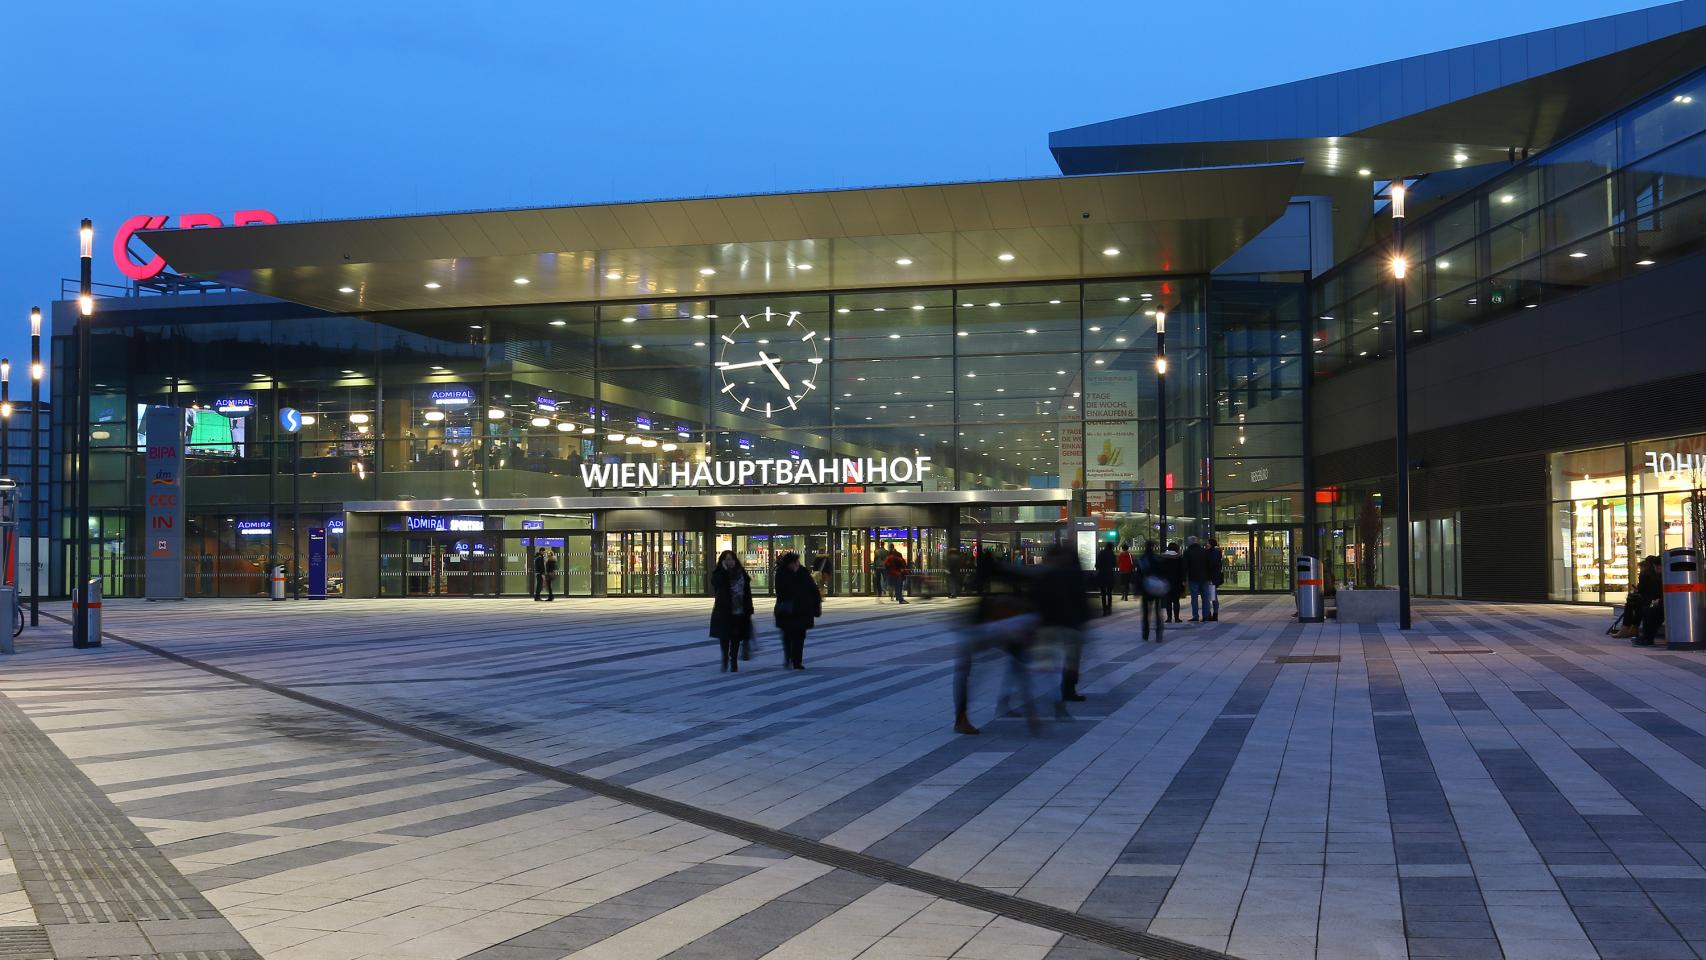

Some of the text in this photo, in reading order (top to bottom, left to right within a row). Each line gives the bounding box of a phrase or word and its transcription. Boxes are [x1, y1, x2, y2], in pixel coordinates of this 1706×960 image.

[431, 391, 473, 399] ADMIRAL
[149, 446, 177, 459] BIPA
[156, 469, 172, 480] dm
[579, 456, 932, 488] WIEN HAUPTBAHNHOF
[148, 494, 177, 507] CCC
[152, 516, 173, 529] IN
[408, 517, 448, 531] ADMIRAL
